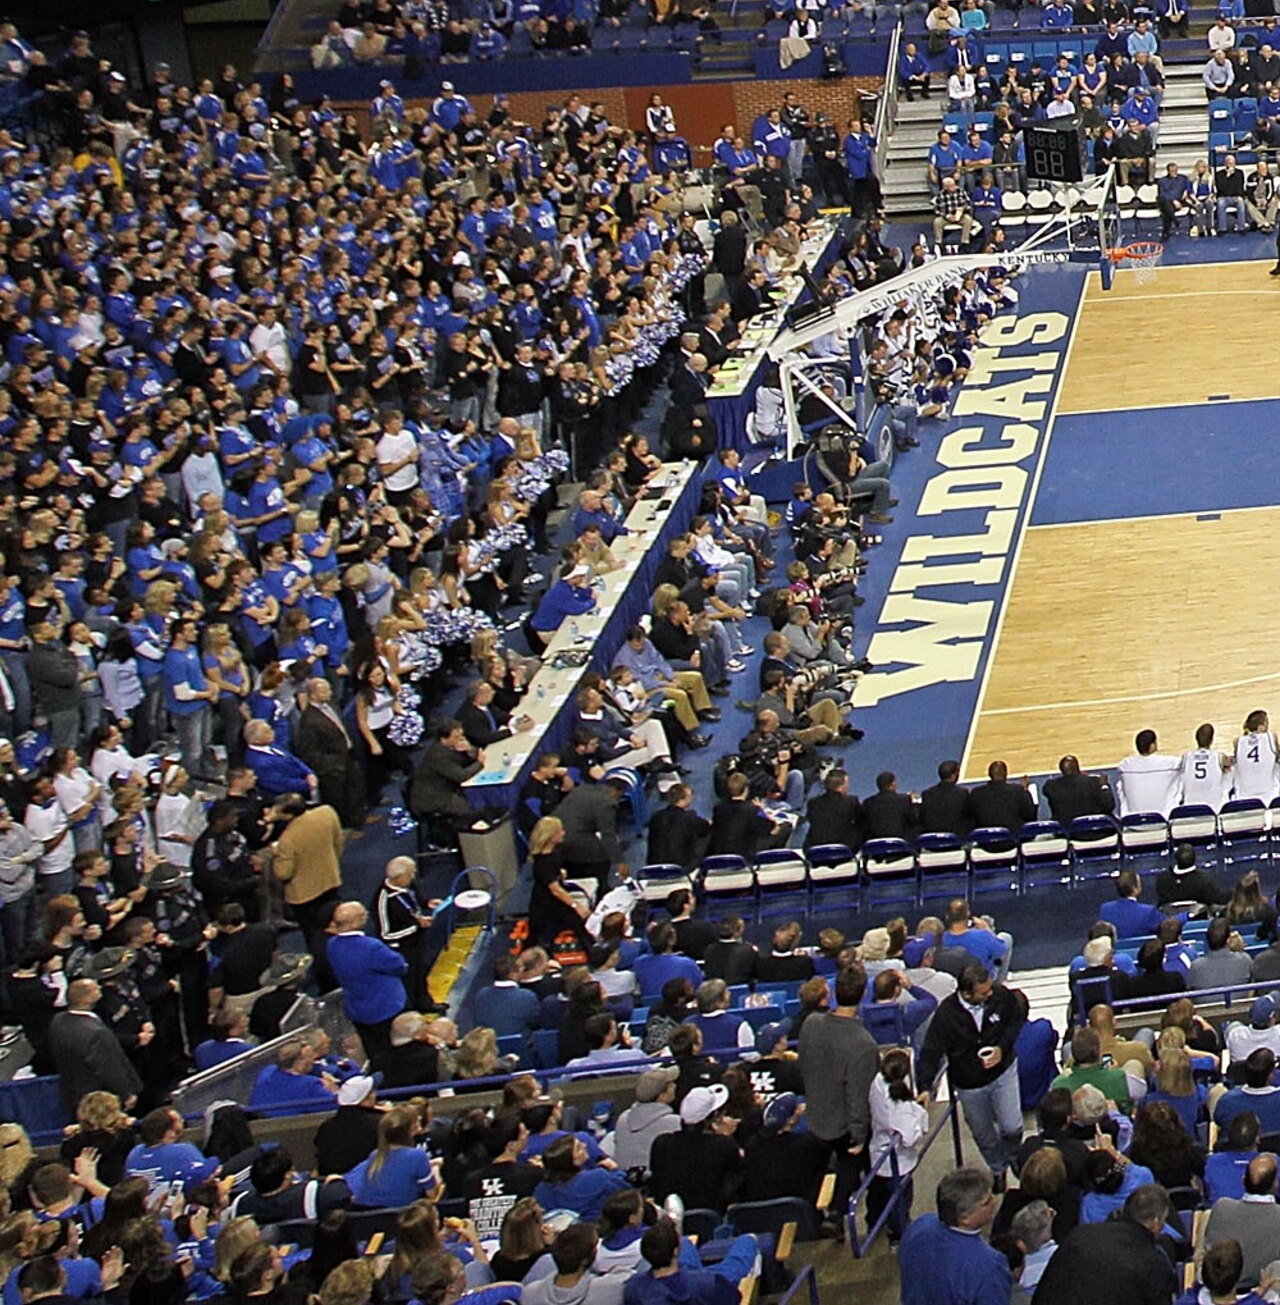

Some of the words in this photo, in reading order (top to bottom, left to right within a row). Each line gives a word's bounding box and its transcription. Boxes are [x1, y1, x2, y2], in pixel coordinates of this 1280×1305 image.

[997, 250, 1071, 265] KENTUCKY
[850, 310, 1069, 708] WILDCATS
[1247, 746, 1260, 764] 4
[1194, 761, 1207, 779] 5
[482, 1178, 505, 1196] UK
